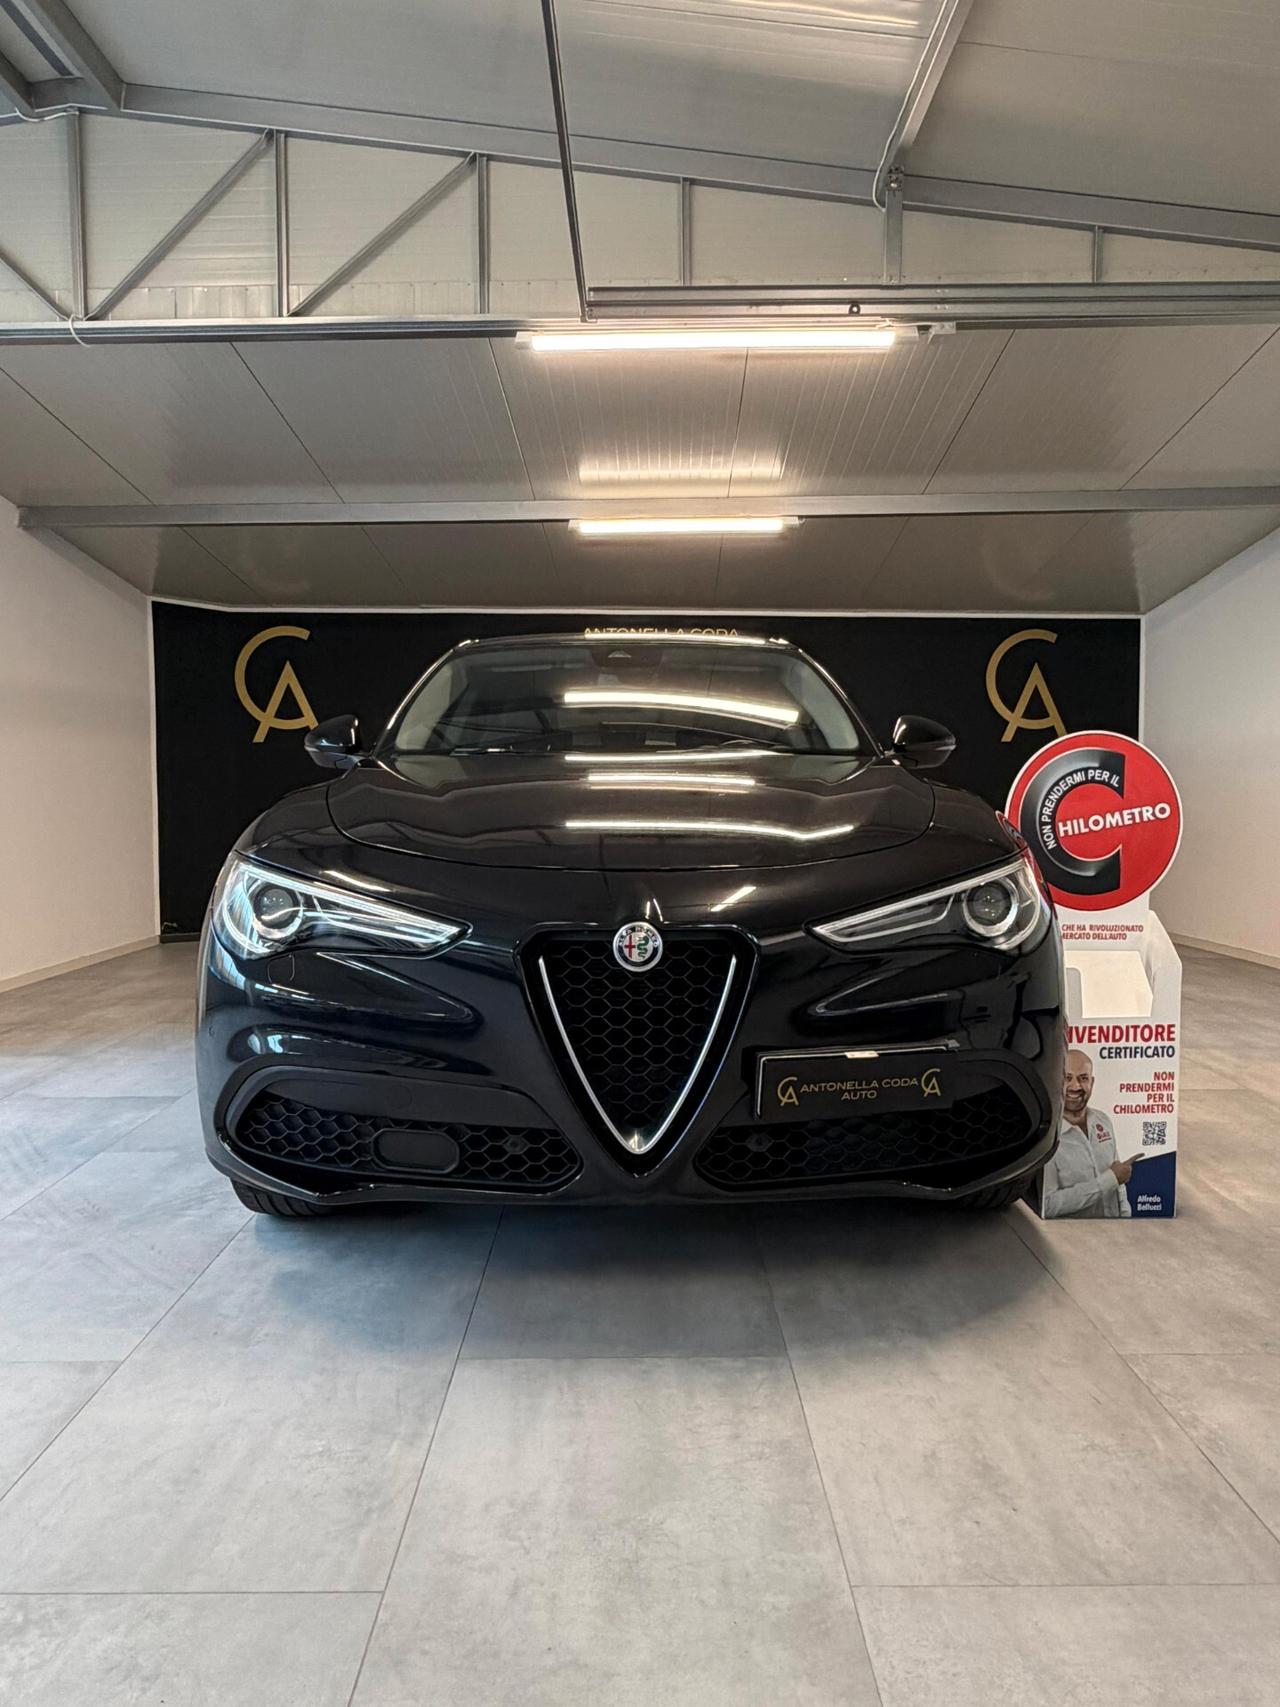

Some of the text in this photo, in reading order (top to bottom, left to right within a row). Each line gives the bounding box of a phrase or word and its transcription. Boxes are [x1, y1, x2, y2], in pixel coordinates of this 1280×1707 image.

[1041, 769, 1120, 850] NON PRENDERMI PER IL
[1061, 924, 1144, 933] CHE HA RIVOLUZIONATO
[1092, 932, 1128, 941] DELL'AUTO
[1067, 1024, 1176, 1044] IVENDITORE
[1099, 1045, 1176, 1060] CERTIFICATO
[1153, 1071, 1175, 1081] NON
[800, 1079, 879, 1093] ANTONELLA
[881, 1077, 919, 1088] CODA
[1119, 1082, 1175, 1093] PRENDERMI
[840, 1090, 877, 1101] AUTO
[1147, 1093, 1175, 1103] PER IL
[1113, 1104, 1174, 1115] CHILOMETRO
[1137, 1194, 1161, 1203] Alfredo
